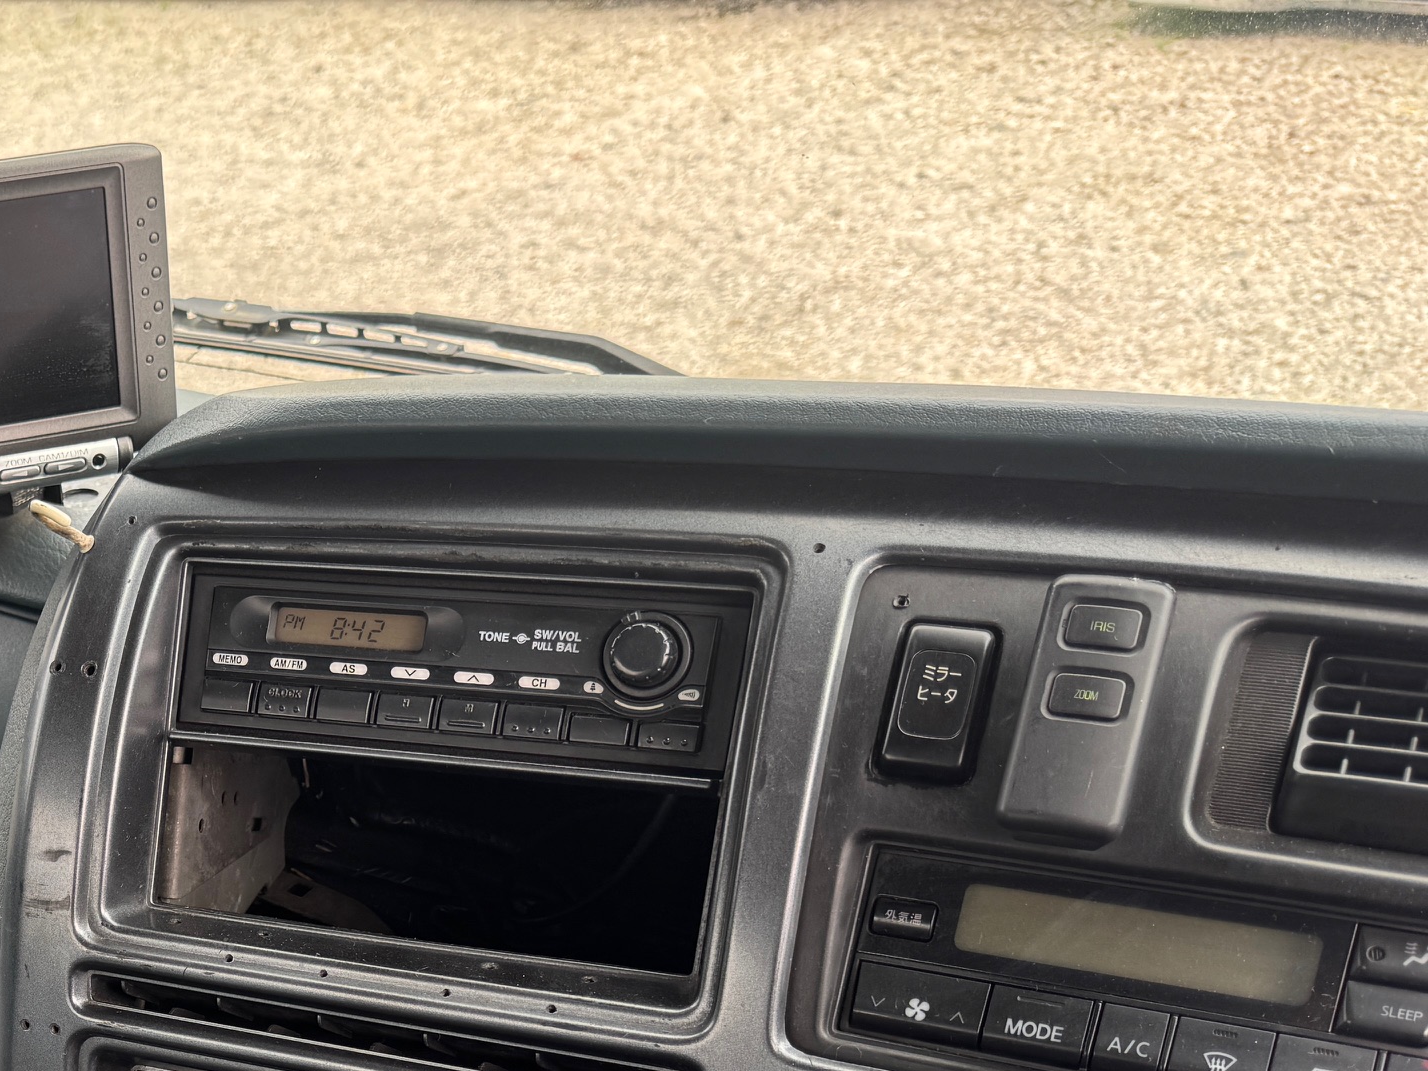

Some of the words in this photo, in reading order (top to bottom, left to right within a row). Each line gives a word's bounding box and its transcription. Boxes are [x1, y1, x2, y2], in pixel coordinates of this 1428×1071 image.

[4, 456, 33, 468] ZOOM
[282, 613, 307, 631] PM
[329, 616, 387, 643] 8:42
[1089, 620, 1116, 633] IRIS
[478, 630, 510, 643] TONE
[533, 629, 582, 642] SW/VOL
[531, 641, 553, 652] PULL
[555, 641, 580, 654] BAL
[218, 654, 243, 665] MEMO
[273, 659, 305, 670] AM/FM
[341, 664, 356, 674] AS
[922, 664, 962, 682] ミラー
[531, 678, 548, 688] CH
[268, 687, 303, 699] CLOCK
[916, 685, 958, 704] ヒータ
[1073, 688, 1100, 702] ZOOM
[884, 909, 922, 927] 外気温
[1380, 1005, 1424, 1022] SLEEP
[1004, 1017, 1065, 1043] MODE
[1106, 1035, 1151, 1060] A/C
